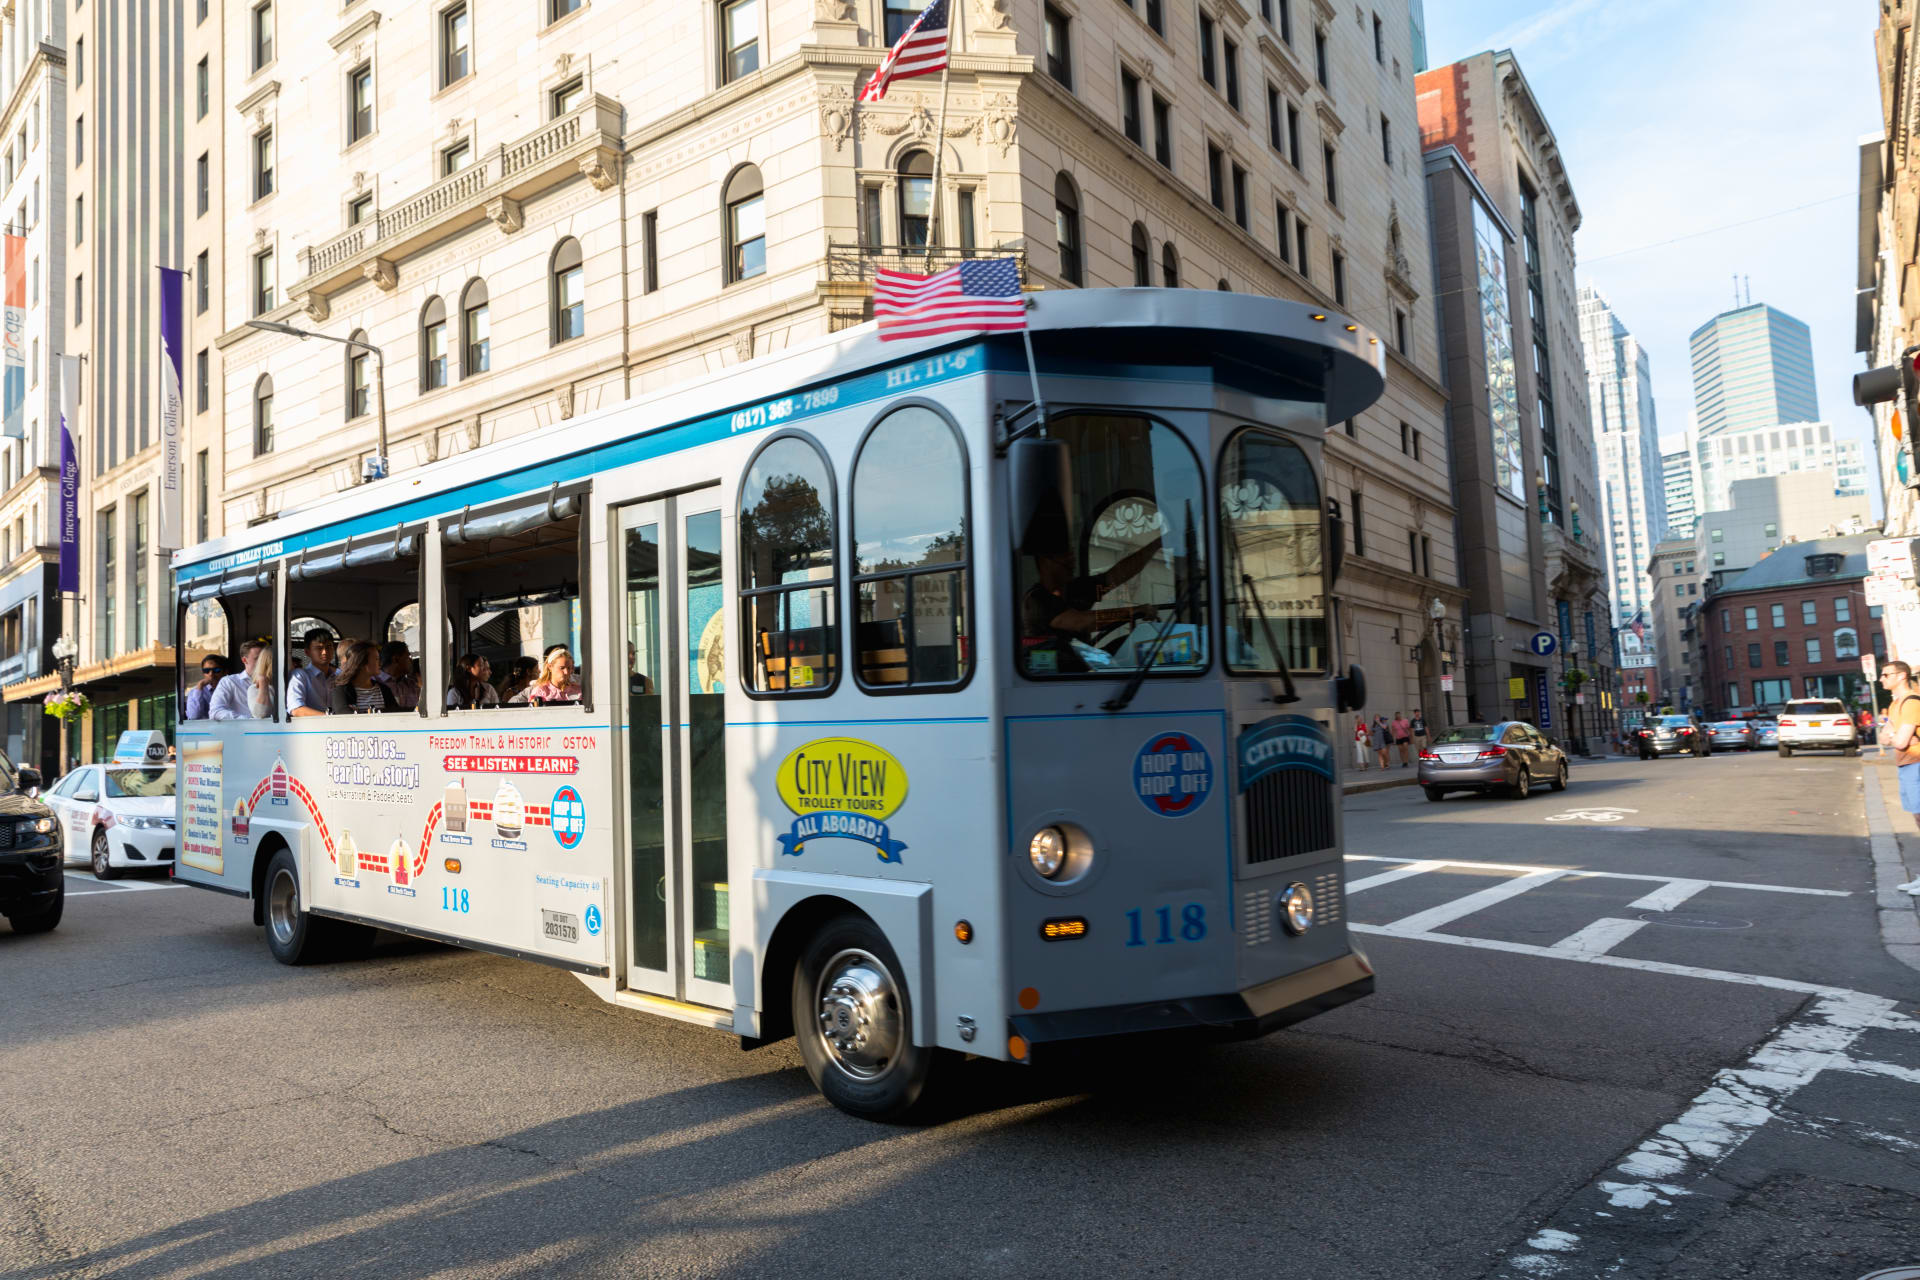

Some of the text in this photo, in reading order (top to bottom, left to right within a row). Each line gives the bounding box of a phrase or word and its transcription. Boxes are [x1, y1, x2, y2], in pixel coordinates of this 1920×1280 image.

[886, 367, 921, 389] HT.
[730, 406, 766, 433] (617)
[803, 386, 839, 412] 7899
[164, 393, 180, 490] Emerson College
[62, 460, 76, 543] Emerson College
[236, 547, 262, 565] TROLLEY
[262, 541, 284, 559] TOURS
[1537, 635, 1551, 653] P
[1538, 679, 1549, 719] PARKING
[148, 747, 165, 755] TAXI
[326, 736, 346, 759] See
[347, 736, 366, 759] the
[429, 735, 467, 750] FREEDOM
[469, 736, 495, 750] TRAIL
[498, 736, 505, 749] &
[562, 737, 597, 750] OSTON
[1245, 736, 1328, 766] CITYVIEW
[352, 763, 371, 785] the
[447, 757, 574, 773] SEE LISTEN LEARN!
[795, 752, 887, 796] CITY VIEW
[1141, 751, 1206, 774] HOP ON
[1140, 773, 1208, 796] HOP OFF
[373, 791, 395, 803] Padded
[396, 792, 413, 804] Seats
[798, 797, 884, 811] TROLLEY TOURS
[797, 815, 884, 842] ALL ABOARD!
[536, 875, 560, 887] Seating
[560, 878, 590, 893] Capacity
[442, 886, 470, 913] 118
[553, 914, 568, 924] US DOT
[1125, 902, 1208, 948] 118
[546, 922, 577, 940] 2031578
